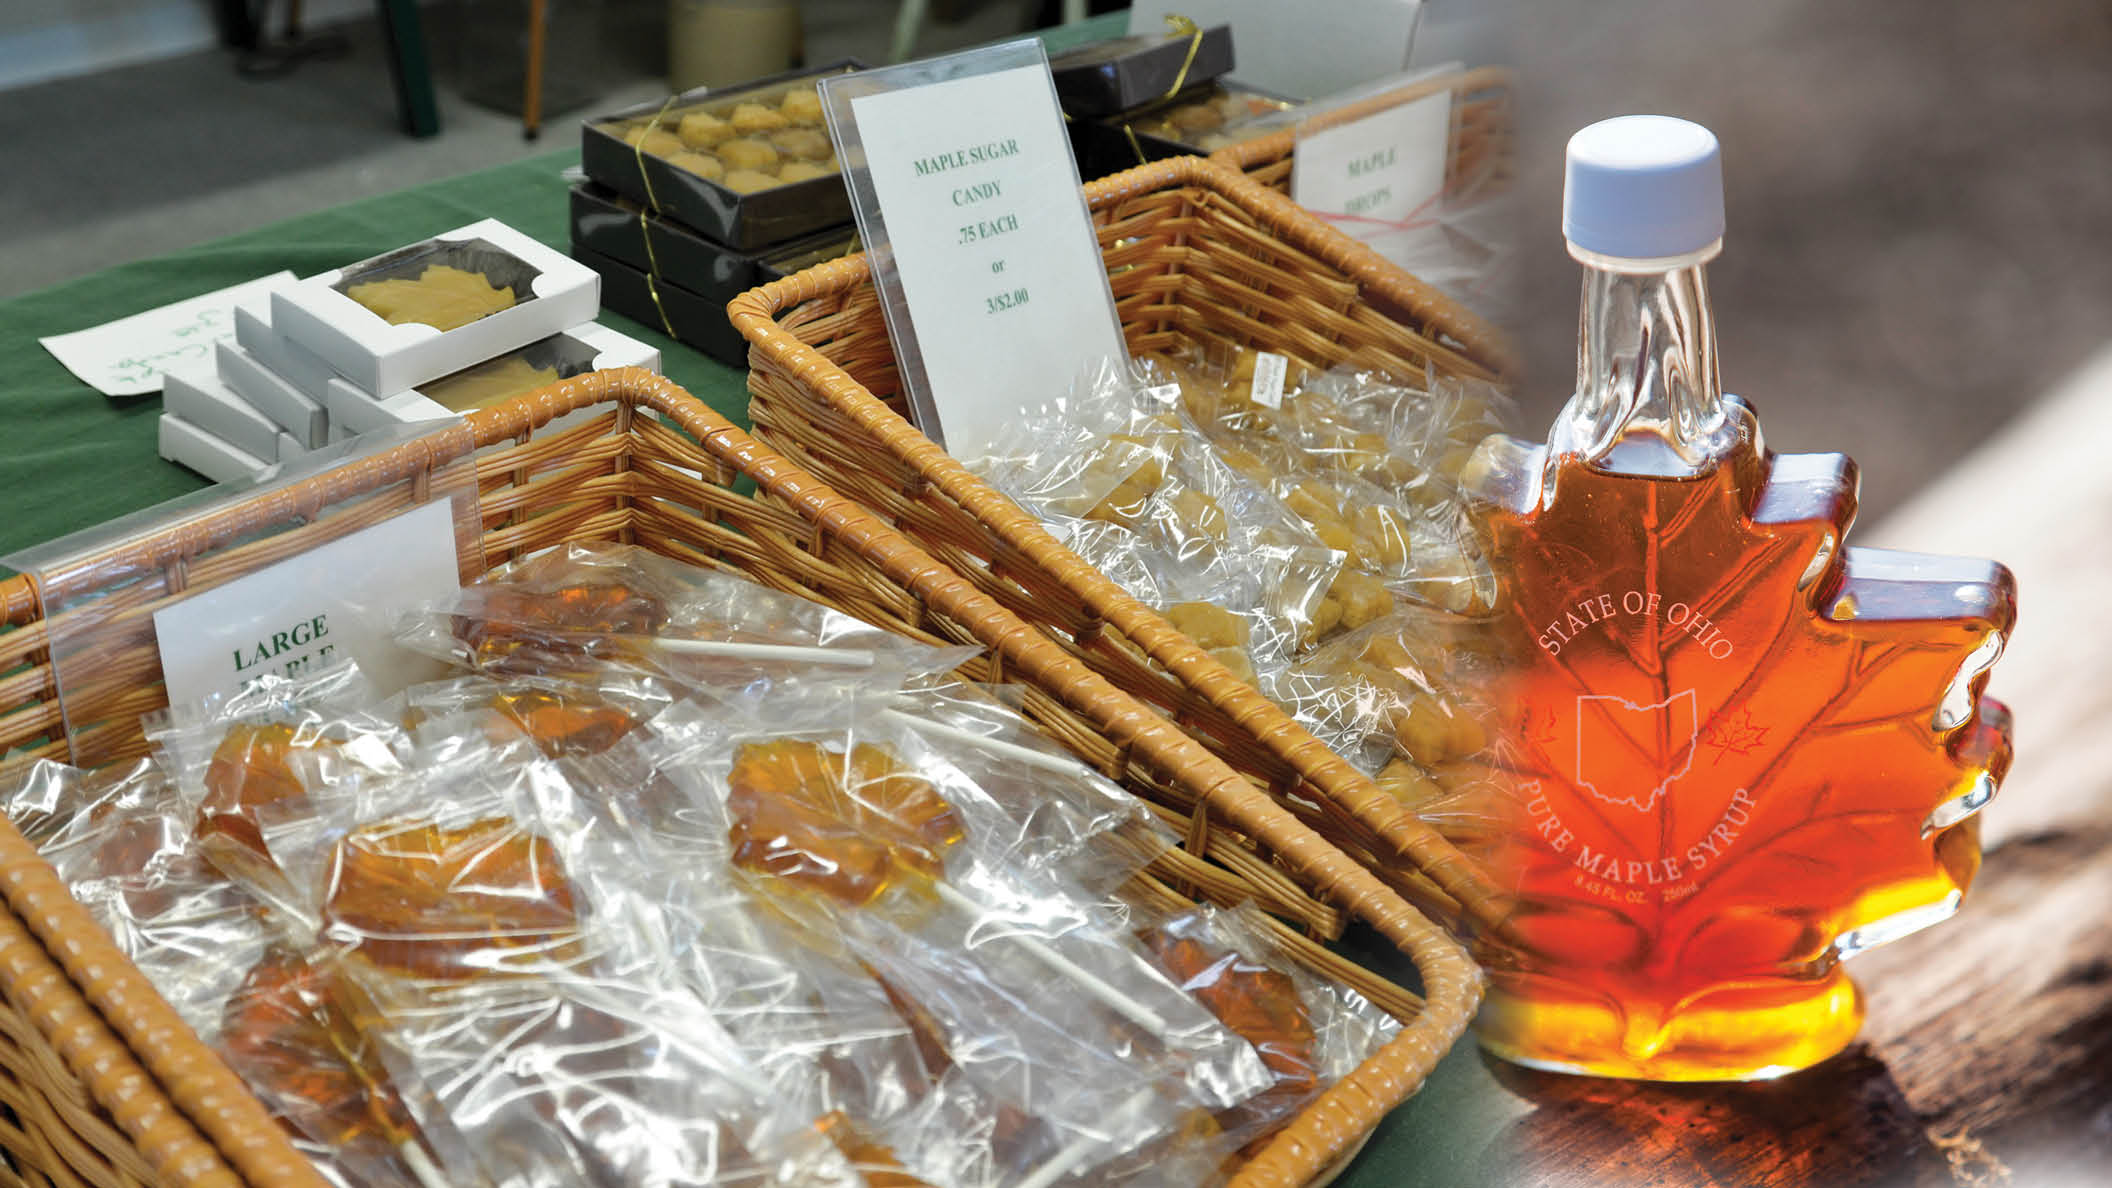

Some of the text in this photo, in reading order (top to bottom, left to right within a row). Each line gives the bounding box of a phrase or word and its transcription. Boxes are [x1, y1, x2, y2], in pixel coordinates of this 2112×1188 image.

[914, 139, 1020, 177] MAPLE SUGAR
[952, 180, 1002, 207] CANDY
[959, 214, 1019, 245] .75 EACH
[992, 259, 1005, 274] or
[986, 287, 1030, 314] 3/$2.00
[233, 614, 329, 671] LARGE
[1538, 591, 1733, 660] STATE OF OHIO
[240, 645, 336, 695] PLE
[1518, 778, 1758, 885] PURE MAPLE SYRUP
